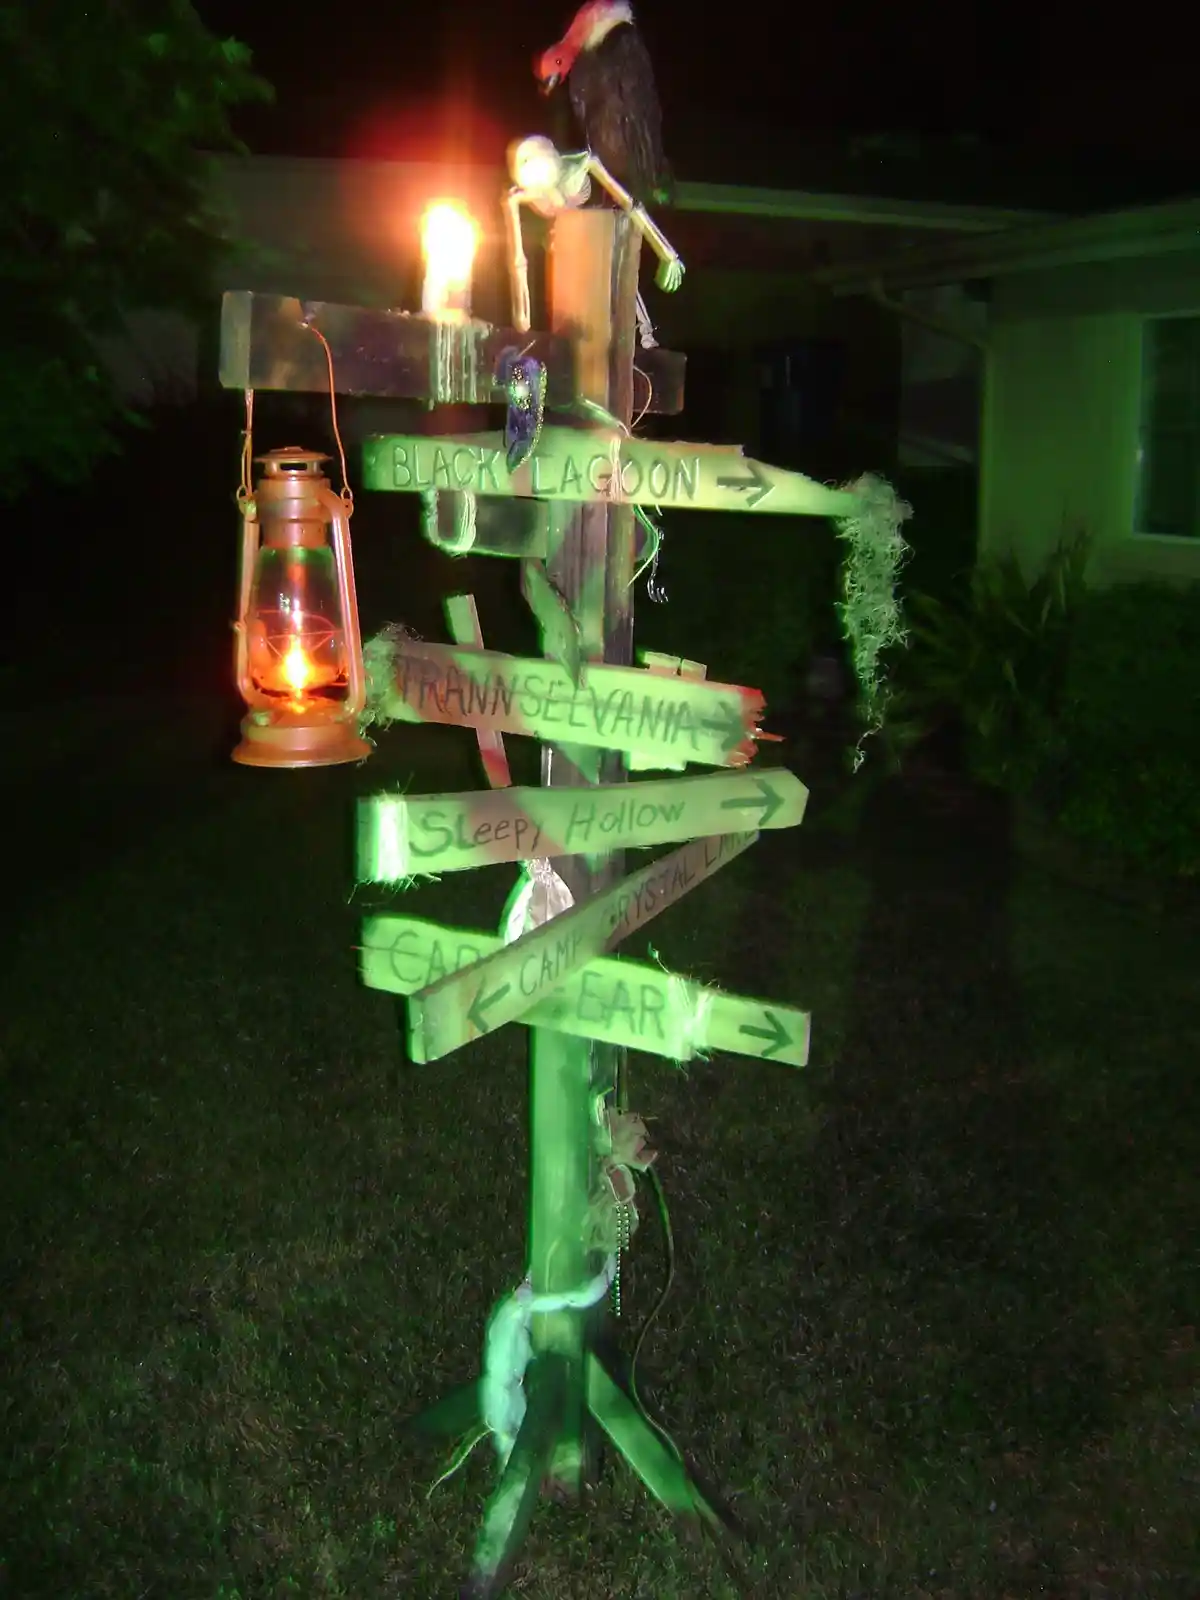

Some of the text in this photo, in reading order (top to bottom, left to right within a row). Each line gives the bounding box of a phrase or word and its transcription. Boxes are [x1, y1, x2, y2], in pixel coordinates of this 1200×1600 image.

[392, 444, 700, 500] BLACK LAGOON
[566, 801, 686, 844] Hollow
[389, 930, 667, 1041] CAP EAR
[519, 929, 583, 997] CAMP
